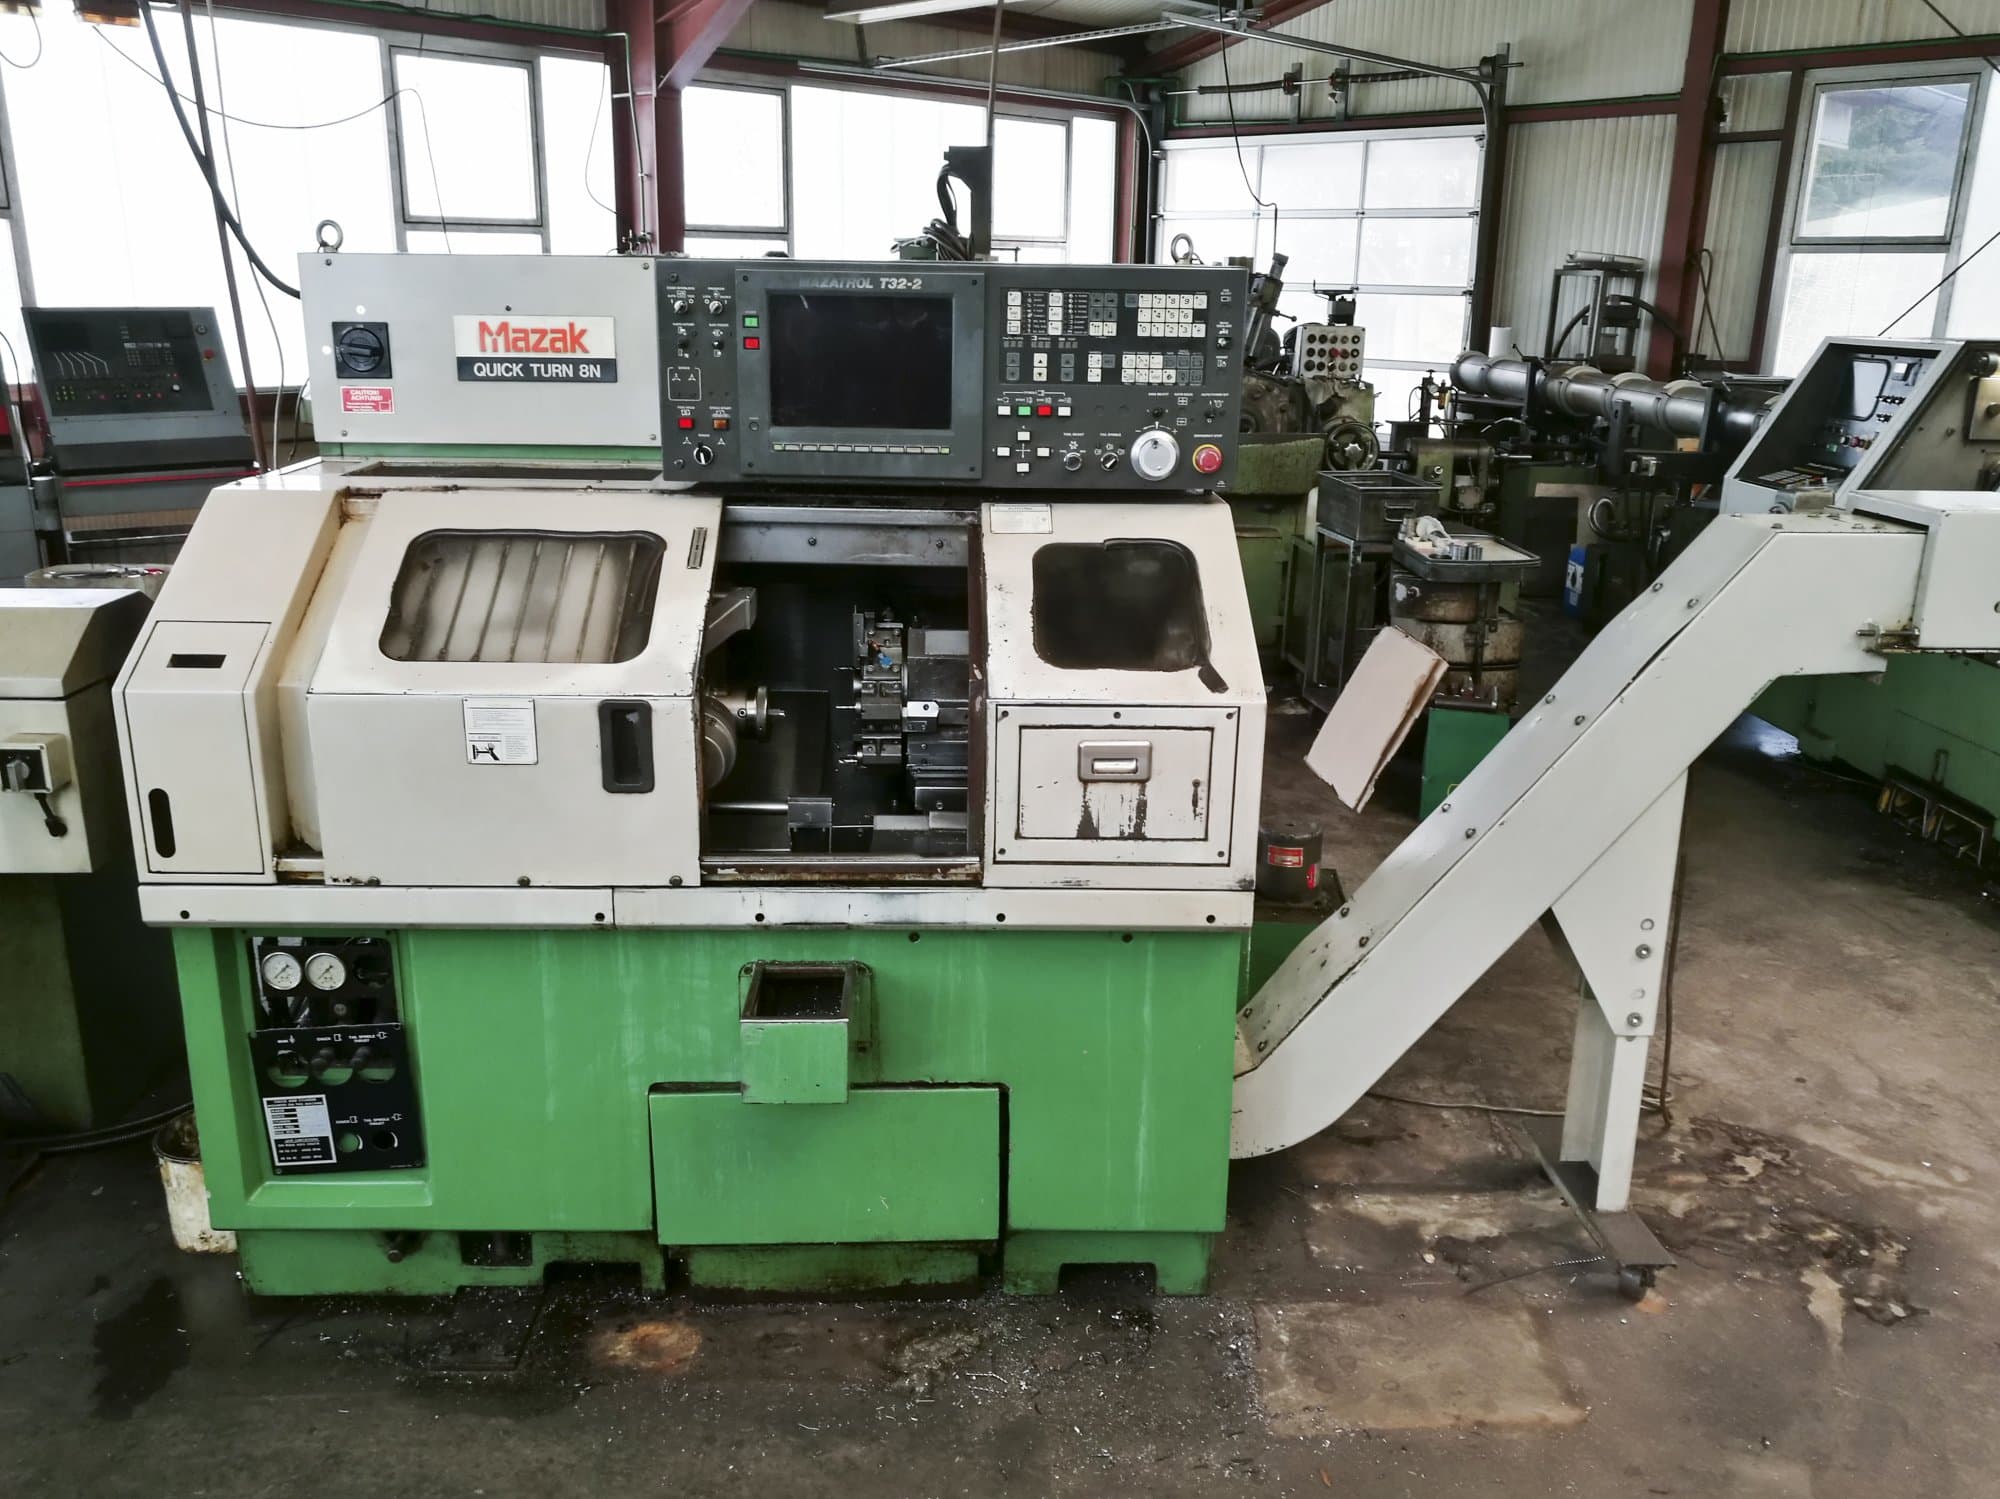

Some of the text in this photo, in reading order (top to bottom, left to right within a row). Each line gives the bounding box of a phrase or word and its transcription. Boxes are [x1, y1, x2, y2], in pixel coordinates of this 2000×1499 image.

[880, 277, 922, 290] T32-2
[478, 321, 590, 354] Mazak
[473, 362, 601, 378] QUICK TURN 8N
